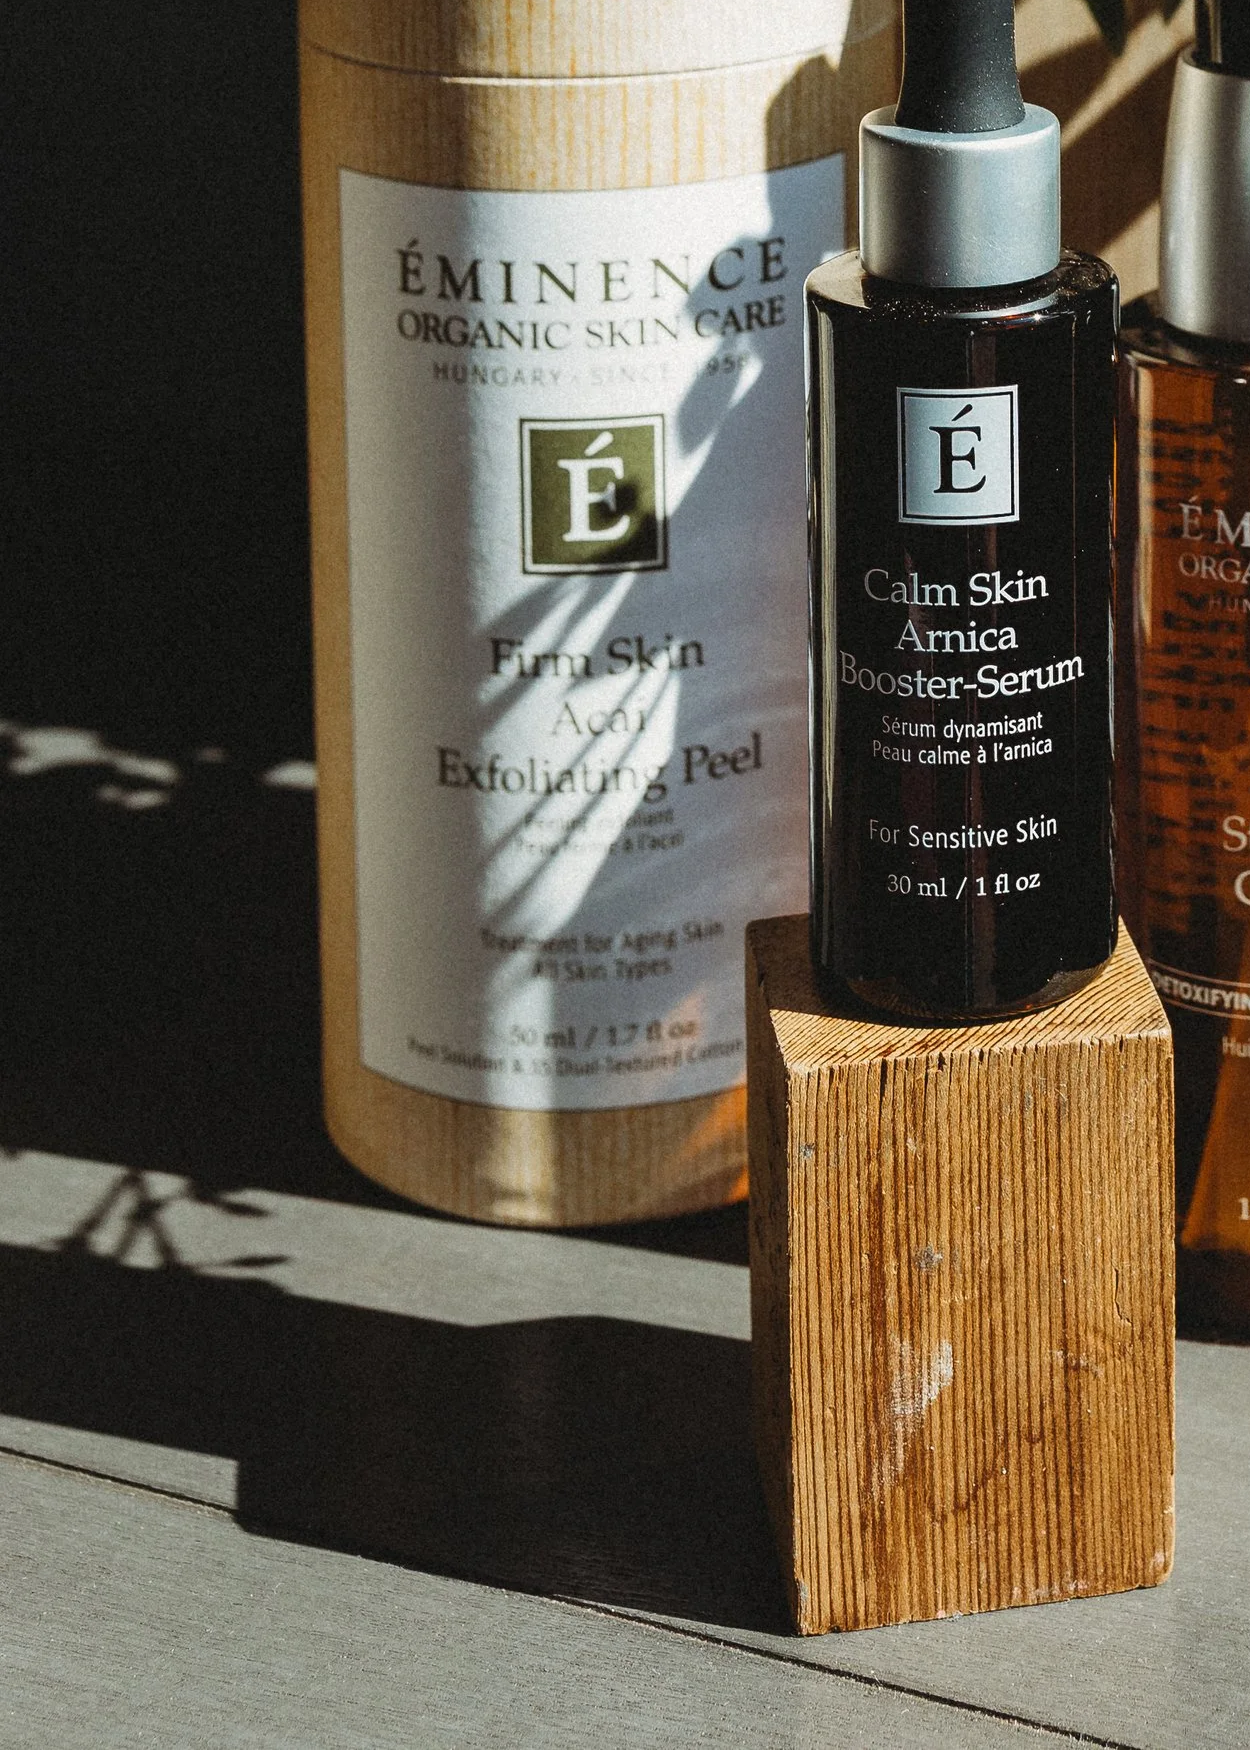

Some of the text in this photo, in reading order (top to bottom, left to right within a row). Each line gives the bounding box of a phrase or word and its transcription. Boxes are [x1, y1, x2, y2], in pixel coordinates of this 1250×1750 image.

[398, 237, 789, 304] ÉMINENCE
[398, 295, 786, 350] ORGANIC SKIN CARE
[433, 361, 560, 387] HUNGARY
[928, 403, 987, 494] É
[558, 431, 631, 542] É
[864, 568, 1049, 607] Calm Skin
[489, 633, 704, 677] Firm Skin
[893, 619, 1019, 653] Arnica
[839, 650, 1085, 700] Booster-Serum
[882, 711, 1043, 743] Sérum dynamisant
[682, 732, 764, 785] Peel
[872, 740, 911, 763] Peau
[918, 745, 971, 765] calme
[977, 747, 987, 764] à
[436, 746, 668, 804] Exfoliating
[869, 814, 1058, 849] For Sensitive Skin
[887, 873, 1041, 900] 30 ml / 1 fl oz
[510, 1024, 537, 1046] 50
[545, 1026, 576, 1048] ml
